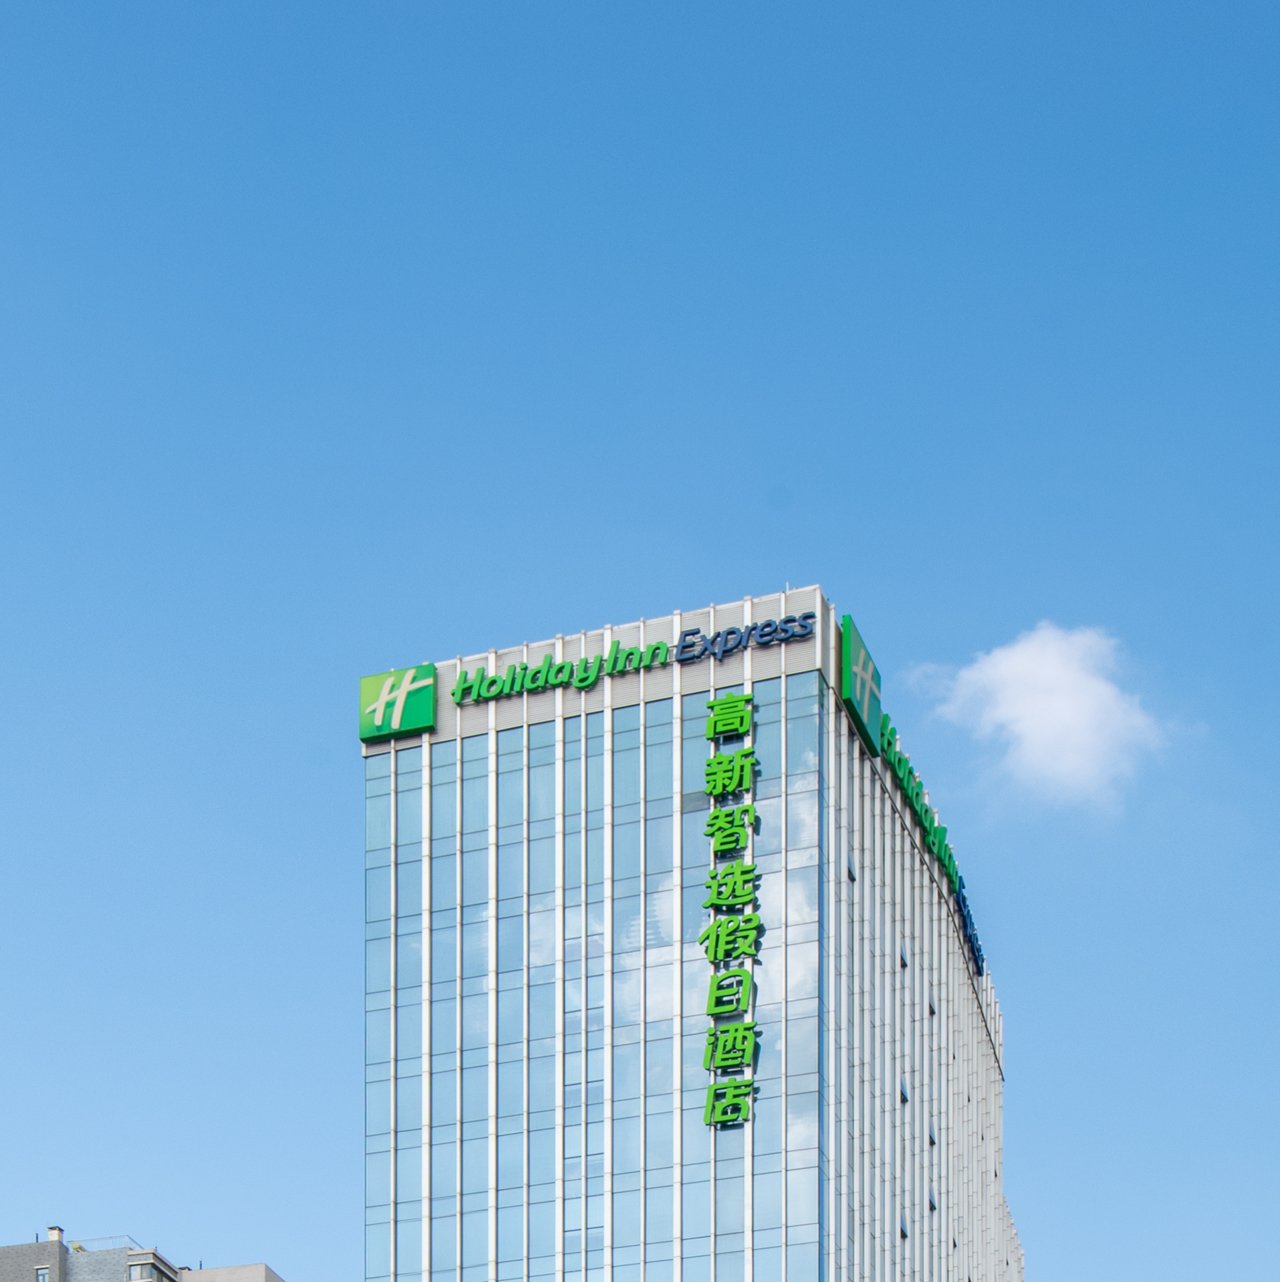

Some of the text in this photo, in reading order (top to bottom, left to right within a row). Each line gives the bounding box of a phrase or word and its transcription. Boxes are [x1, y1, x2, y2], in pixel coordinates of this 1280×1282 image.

[674, 611, 816, 662] Express
[698, 691, 760, 1126] 高新智选假日酒店
